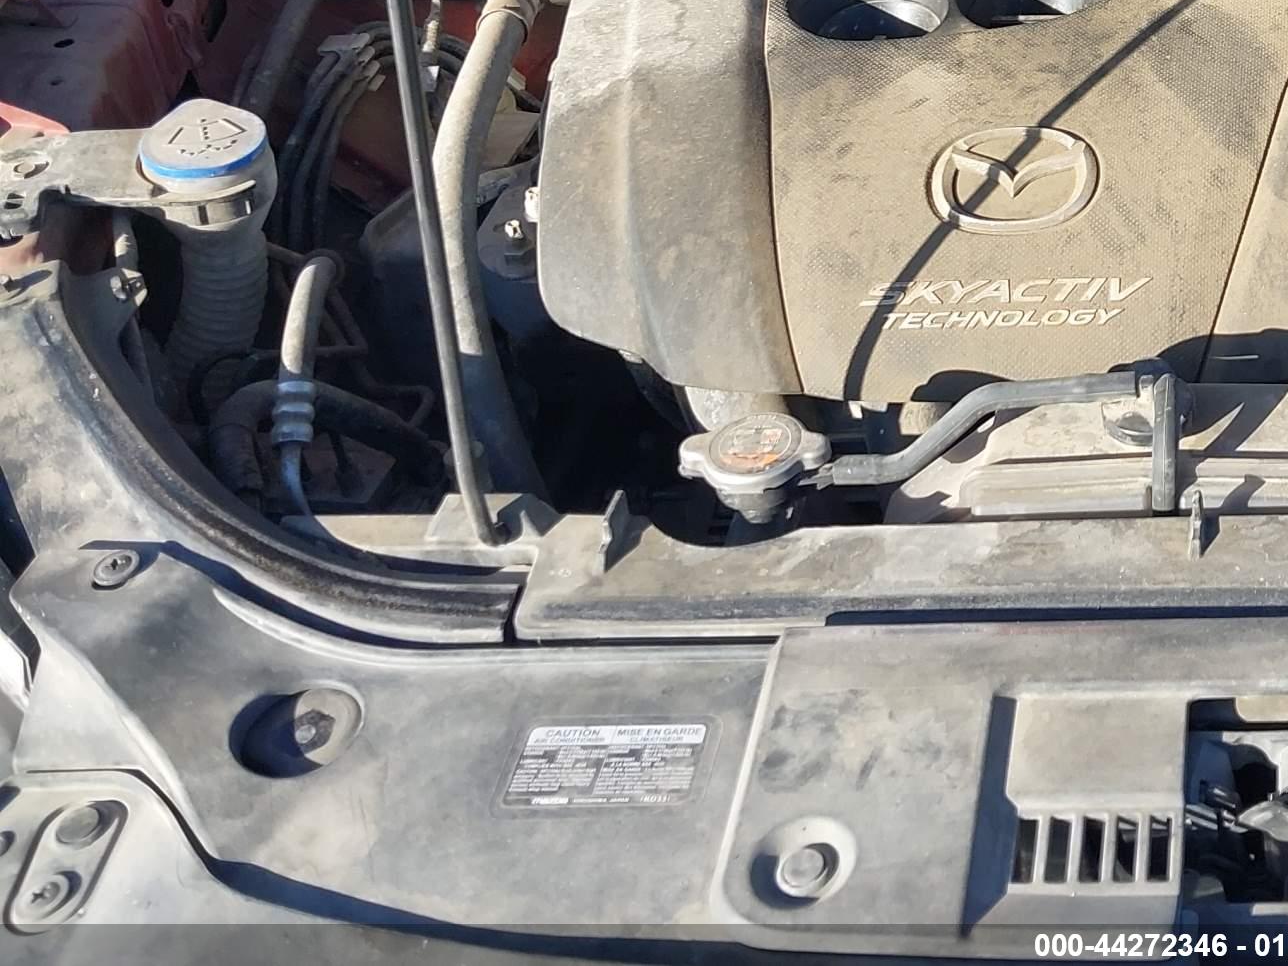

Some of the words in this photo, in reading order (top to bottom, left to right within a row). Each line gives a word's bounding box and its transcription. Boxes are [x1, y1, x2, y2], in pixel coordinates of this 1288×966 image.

[859, 276, 1154, 307] SKYACTIV
[882, 307, 1125, 331] TECHNOLOGY
[545, 729, 601, 737] CAUTION
[617, 728, 641, 737] MISE
[646, 728, 662, 736] EN
[663, 727, 702, 736] GARDE
